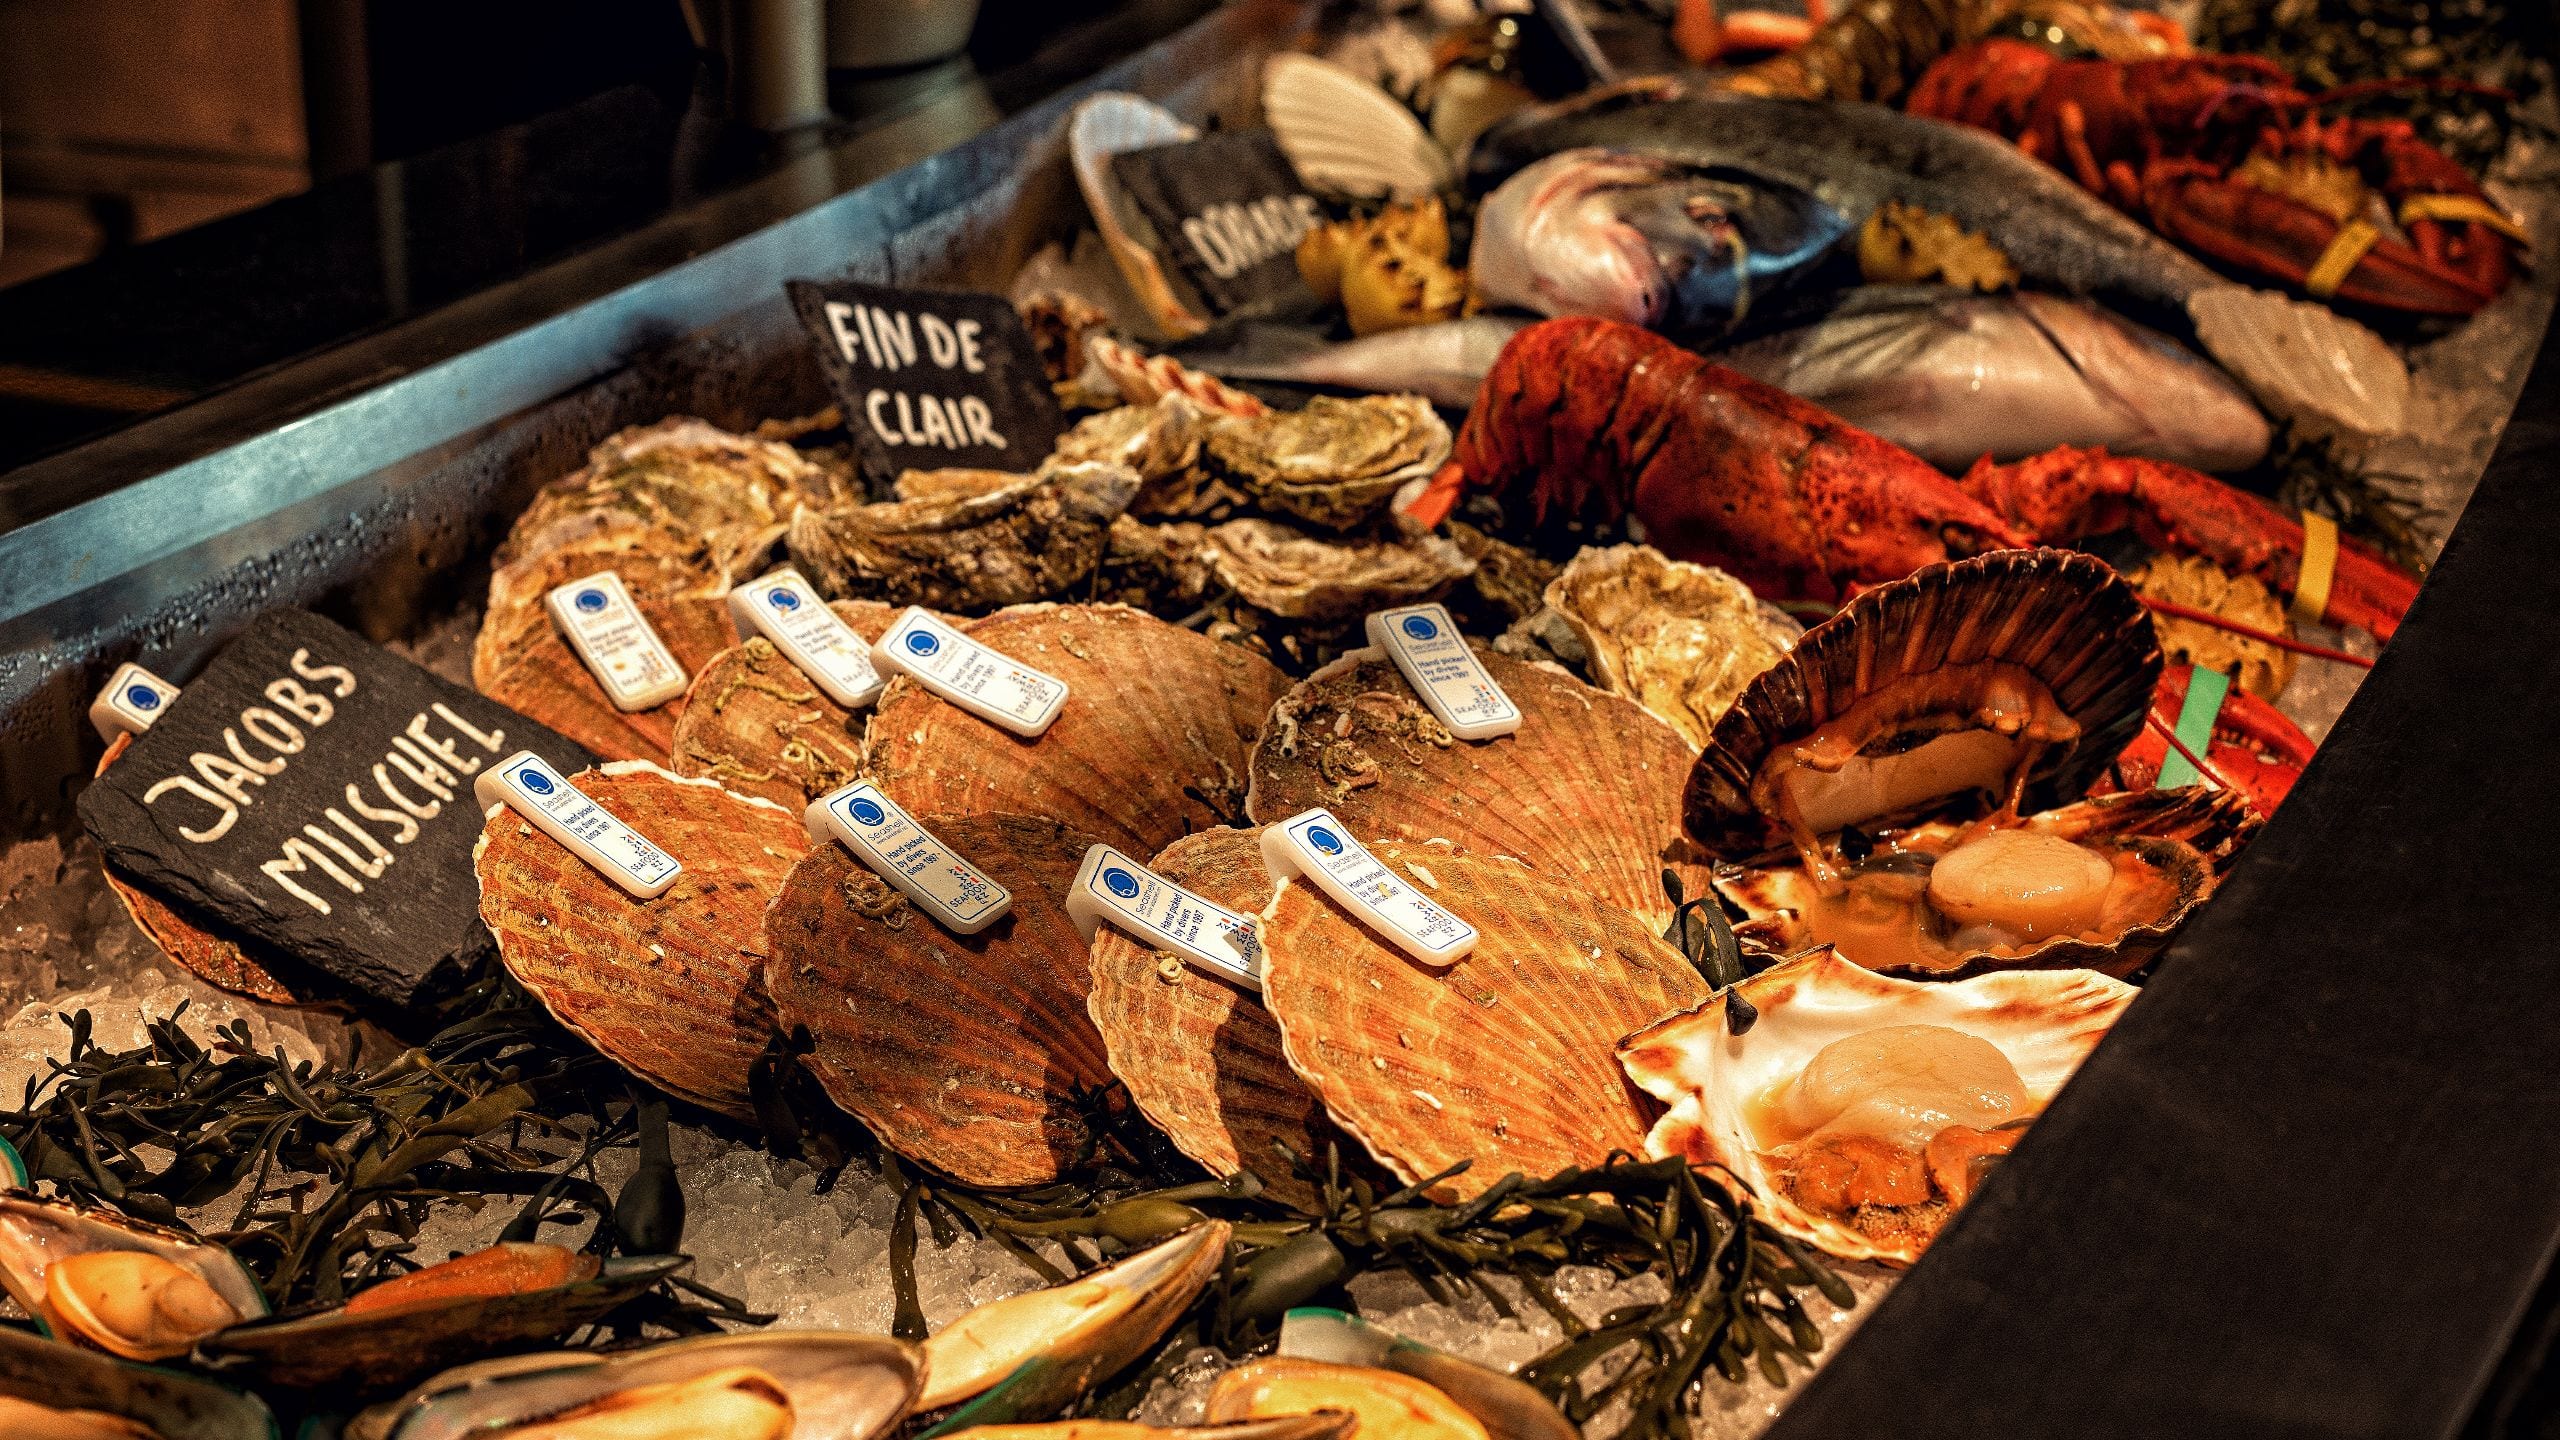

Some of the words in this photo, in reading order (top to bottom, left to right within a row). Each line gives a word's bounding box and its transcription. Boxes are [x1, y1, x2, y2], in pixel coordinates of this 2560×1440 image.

[824, 302, 917, 372] FIN
[918, 312, 986, 374] DE
[866, 388, 1008, 450] CLAIR
[143, 647, 358, 844] JACOBS
[259, 701, 506, 916] MUSCHEL
[563, 812, 581, 826] Hand
[577, 803, 595, 819] picked
[573, 825, 587, 834] by
[581, 816, 598, 829] divers
[585, 829, 602, 841] since
[867, 818, 905, 841] Seashell
[885, 845, 906, 860] Hand
[904, 835, 927, 851] picked
[895, 859, 911, 869] by
[905, 849, 927, 863] divers
[906, 862, 926, 876] since
[922, 853, 940, 865] 1997
[1327, 851, 1362, 870] Seashell
[1347, 876, 1367, 890] Hand
[1365, 868, 1385, 883] picked
[949, 883, 987, 907] SEAFOOD
[1135, 880, 1156, 915] Seashell
[1357, 890, 1371, 898] by
[1369, 894, 1389, 906] since
[1160, 911, 1175, 930] Hand
[1168, 892, 1183, 915] picked
[1176, 908, 1191, 928] divers
[1192, 909, 1205, 925] 1997
[1172, 927, 1186, 937] by
[1186, 925, 1199, 943] since
